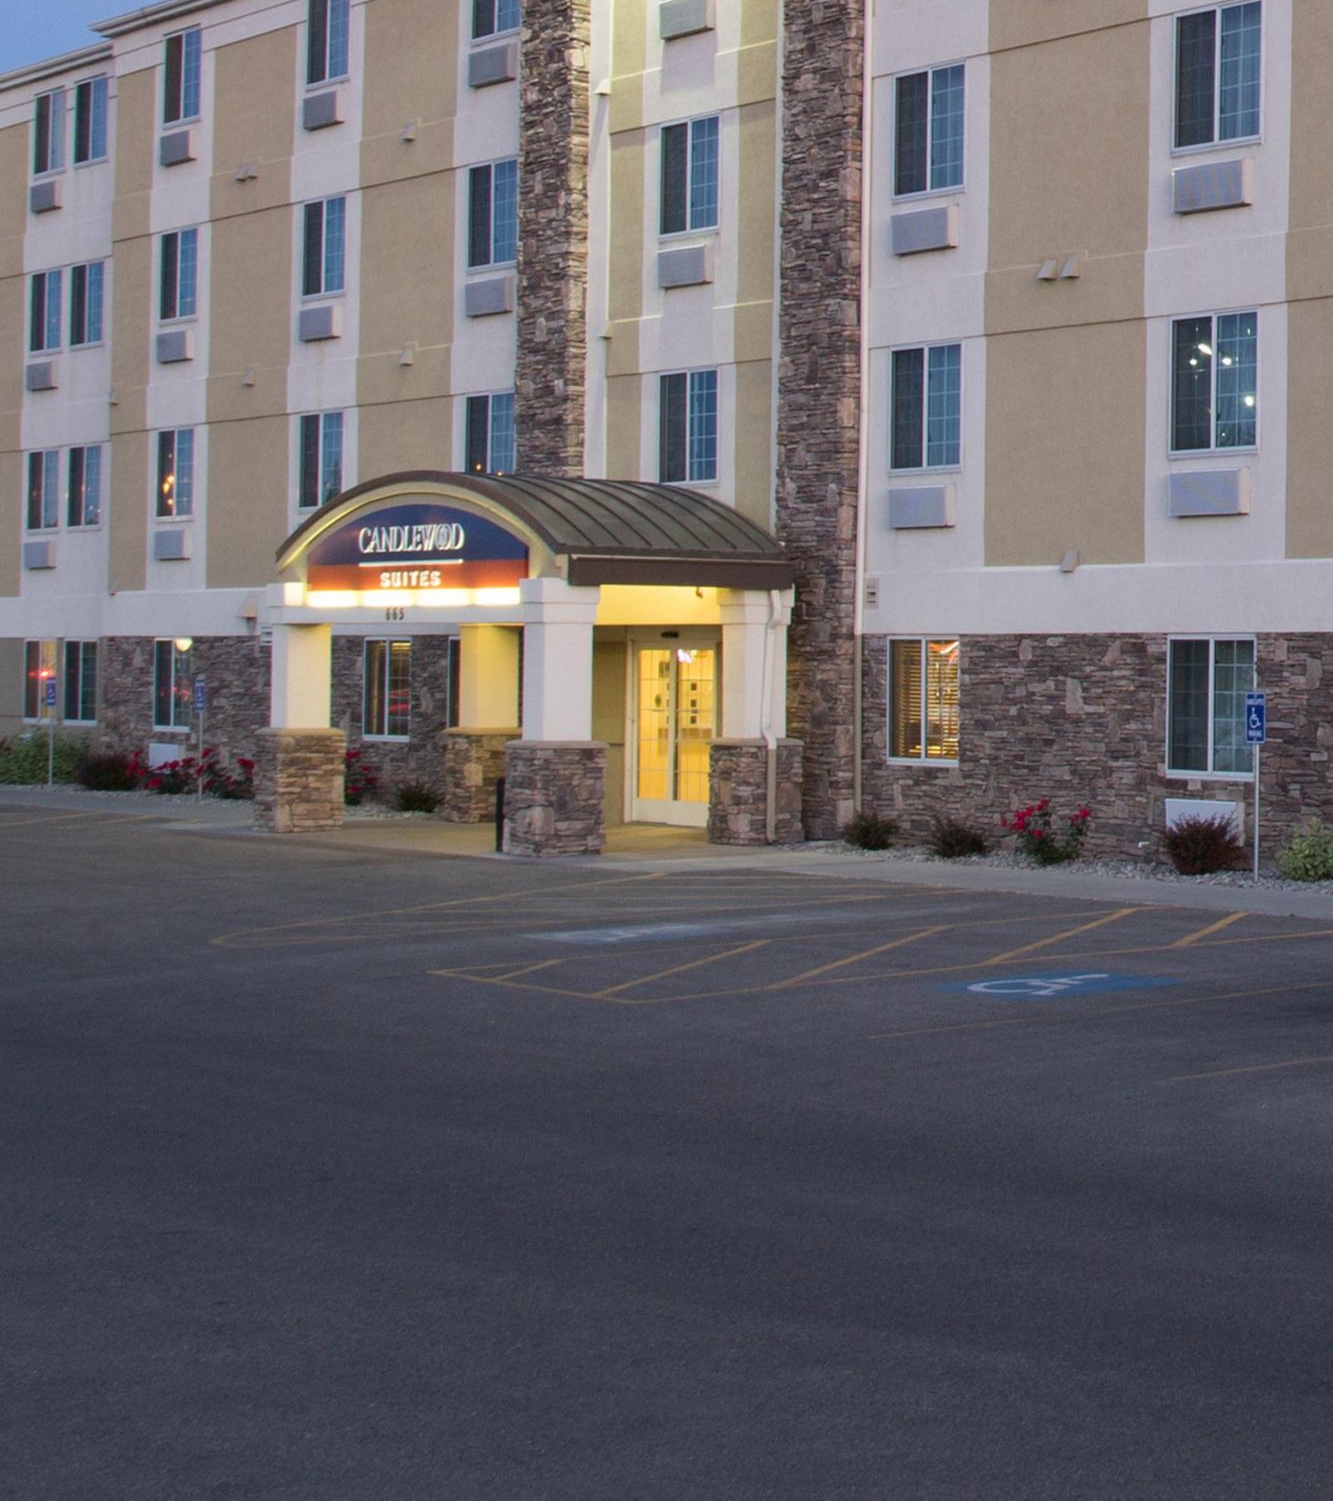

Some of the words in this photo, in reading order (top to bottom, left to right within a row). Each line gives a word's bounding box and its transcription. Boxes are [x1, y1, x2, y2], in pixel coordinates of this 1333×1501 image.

[358, 523, 465, 554] CANDLEWOOD
[379, 570, 442, 589] SUITES
[385, 607, 405, 621] 665
